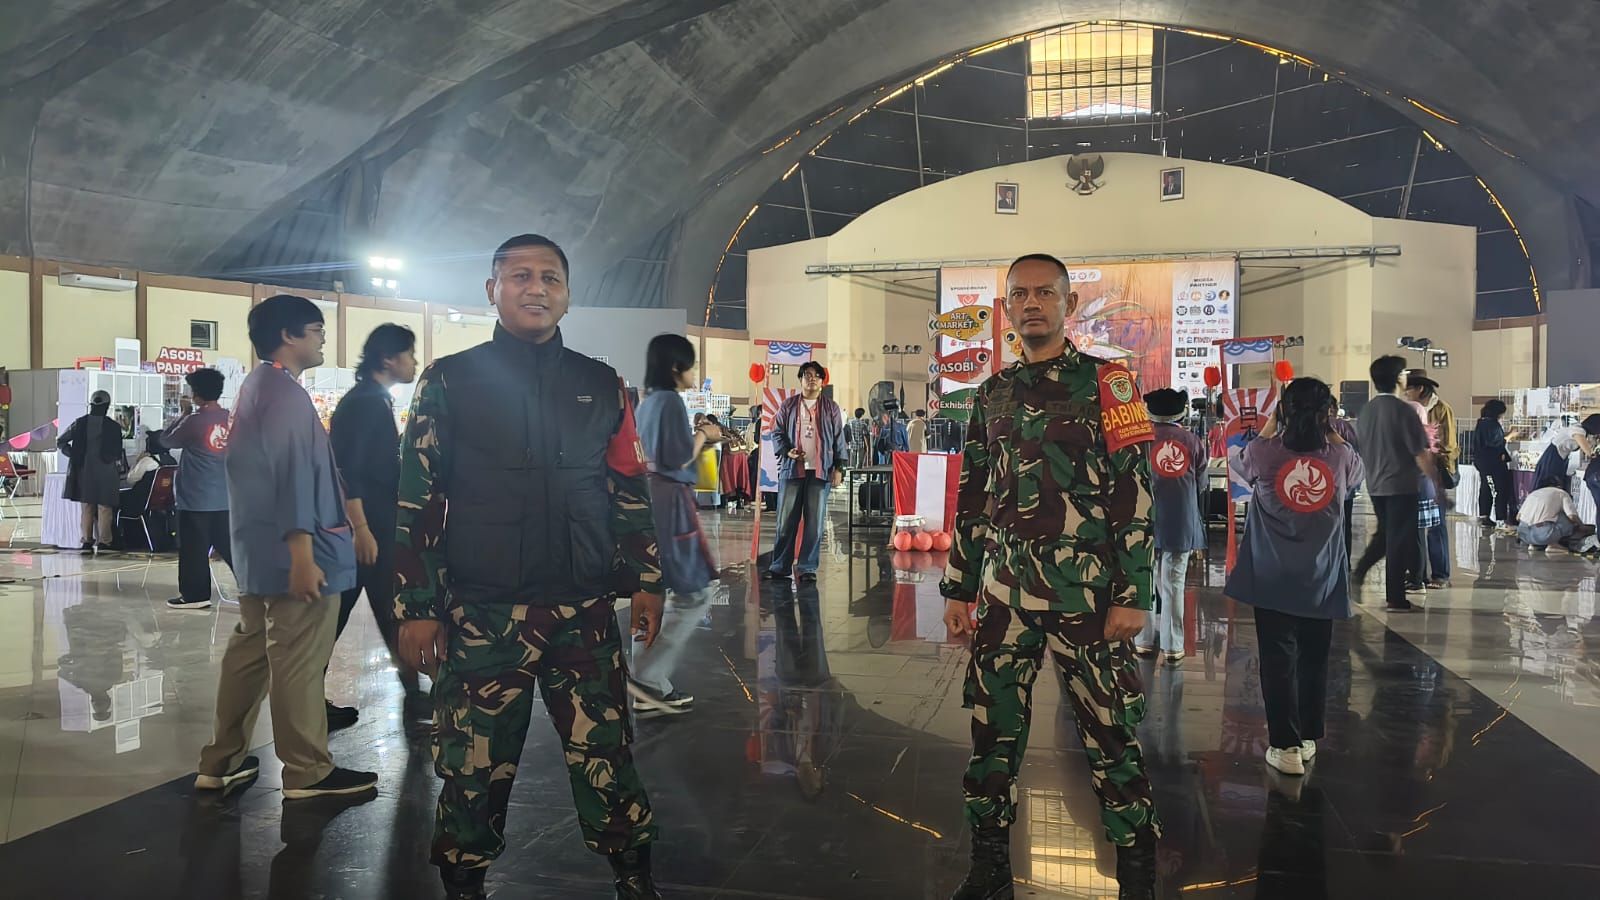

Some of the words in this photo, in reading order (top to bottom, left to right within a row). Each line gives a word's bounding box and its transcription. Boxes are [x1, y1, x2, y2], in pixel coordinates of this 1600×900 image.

[950, 312, 966, 320] ART
[940, 320, 974, 329] MARKET
[159, 347, 202, 362] ASOBI
[156, 361, 190, 374] PARK
[940, 362, 974, 372] ASOBI
